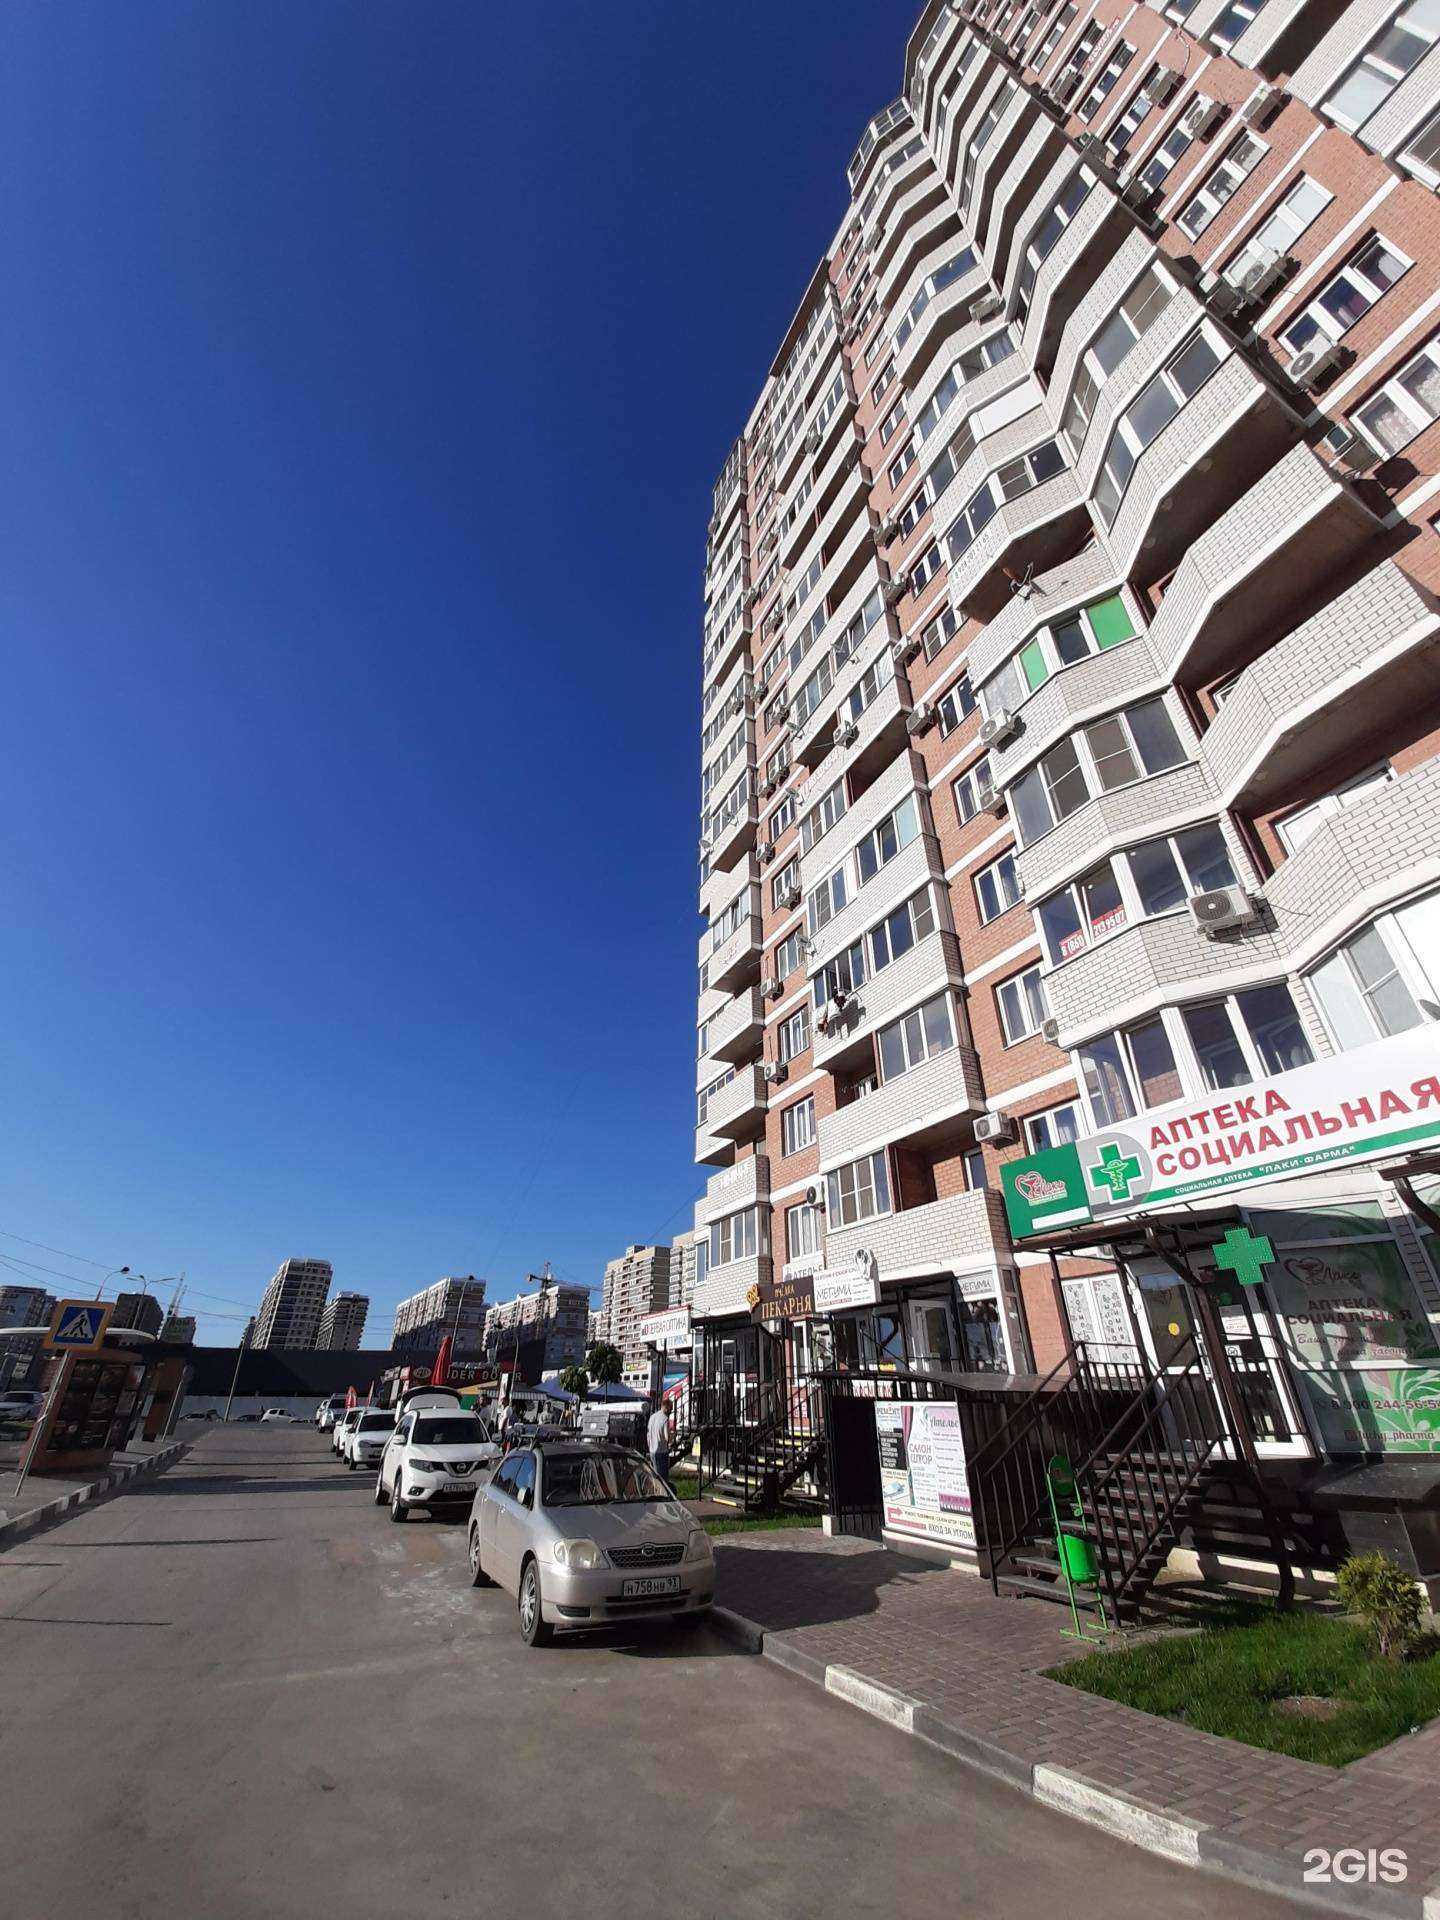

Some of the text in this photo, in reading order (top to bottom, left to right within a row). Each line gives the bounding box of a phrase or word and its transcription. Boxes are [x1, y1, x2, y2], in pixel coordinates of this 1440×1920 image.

[1150, 1089, 1292, 1150] АПТЕКА
[1156, 1075, 1440, 1176] СОЦИАЛЬНАЯ
[1174, 1177, 1224, 1195] СОЦИАЛЬНАЯ
[1223, 1170, 1253, 1185] АПТЕКА
[761, 1294, 813, 1319] ПЕКАРНЯ
[1308, 1296, 1379, 1312] АПТЕКА
[908, 1442, 932, 1454] САЛОН
[910, 1453, 933, 1465] ШТОР
[928, 1523, 974, 1540] ВХОД ЗА УГЛОМ
